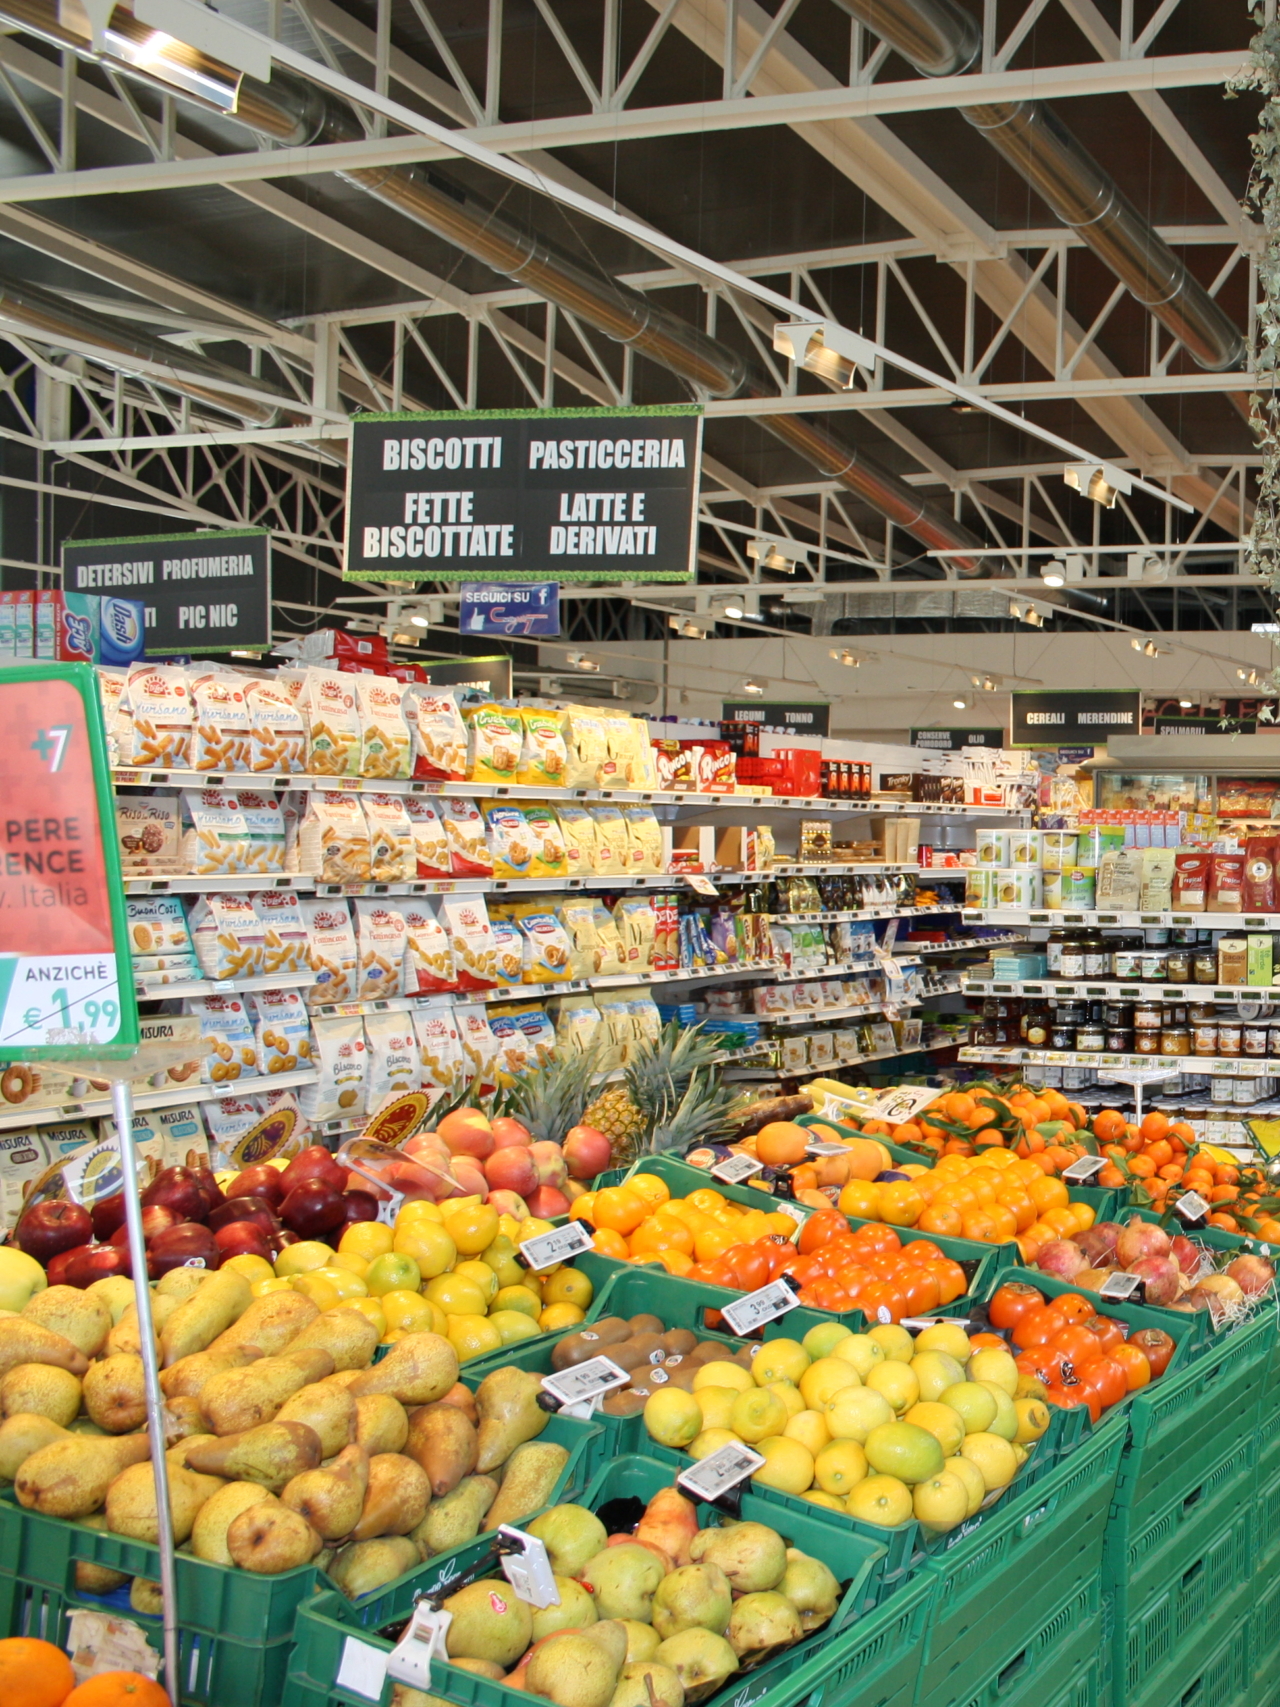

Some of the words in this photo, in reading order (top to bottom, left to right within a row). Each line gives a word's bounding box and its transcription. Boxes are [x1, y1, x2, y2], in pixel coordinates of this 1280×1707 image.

[383, 437, 502, 470] BISCOTTI
[529, 439, 686, 470] PASTICCERIA
[404, 492, 474, 524] FETTE
[559, 493, 627, 522] LATTE
[631, 493, 645, 522] E
[363, 524, 514, 558] BISCOTTATE
[549, 526, 657, 555] DERIVATI
[77, 561, 154, 588] DETERSIVI
[162, 554, 254, 581] PROFUMERIA
[466, 591, 512, 603] SEGUICI
[514, 591, 530, 603] SU
[112, 602, 133, 644] Dash
[178, 605, 207, 630] PIC
[209, 603, 239, 628] NIC
[735, 710, 765, 721] LEGUMI
[785, 712, 814, 724] TONNO
[1026, 712, 1066, 725] CEREALI
[1077, 712, 1133, 725] MERENDINE
[917, 731, 951, 740] CONSERVE
[968, 734, 985, 743] OLIO
[7, 818, 81, 843] PERE
[20, 883, 88, 908] Italia
[25, 960, 108, 982] ANZICHÈ
